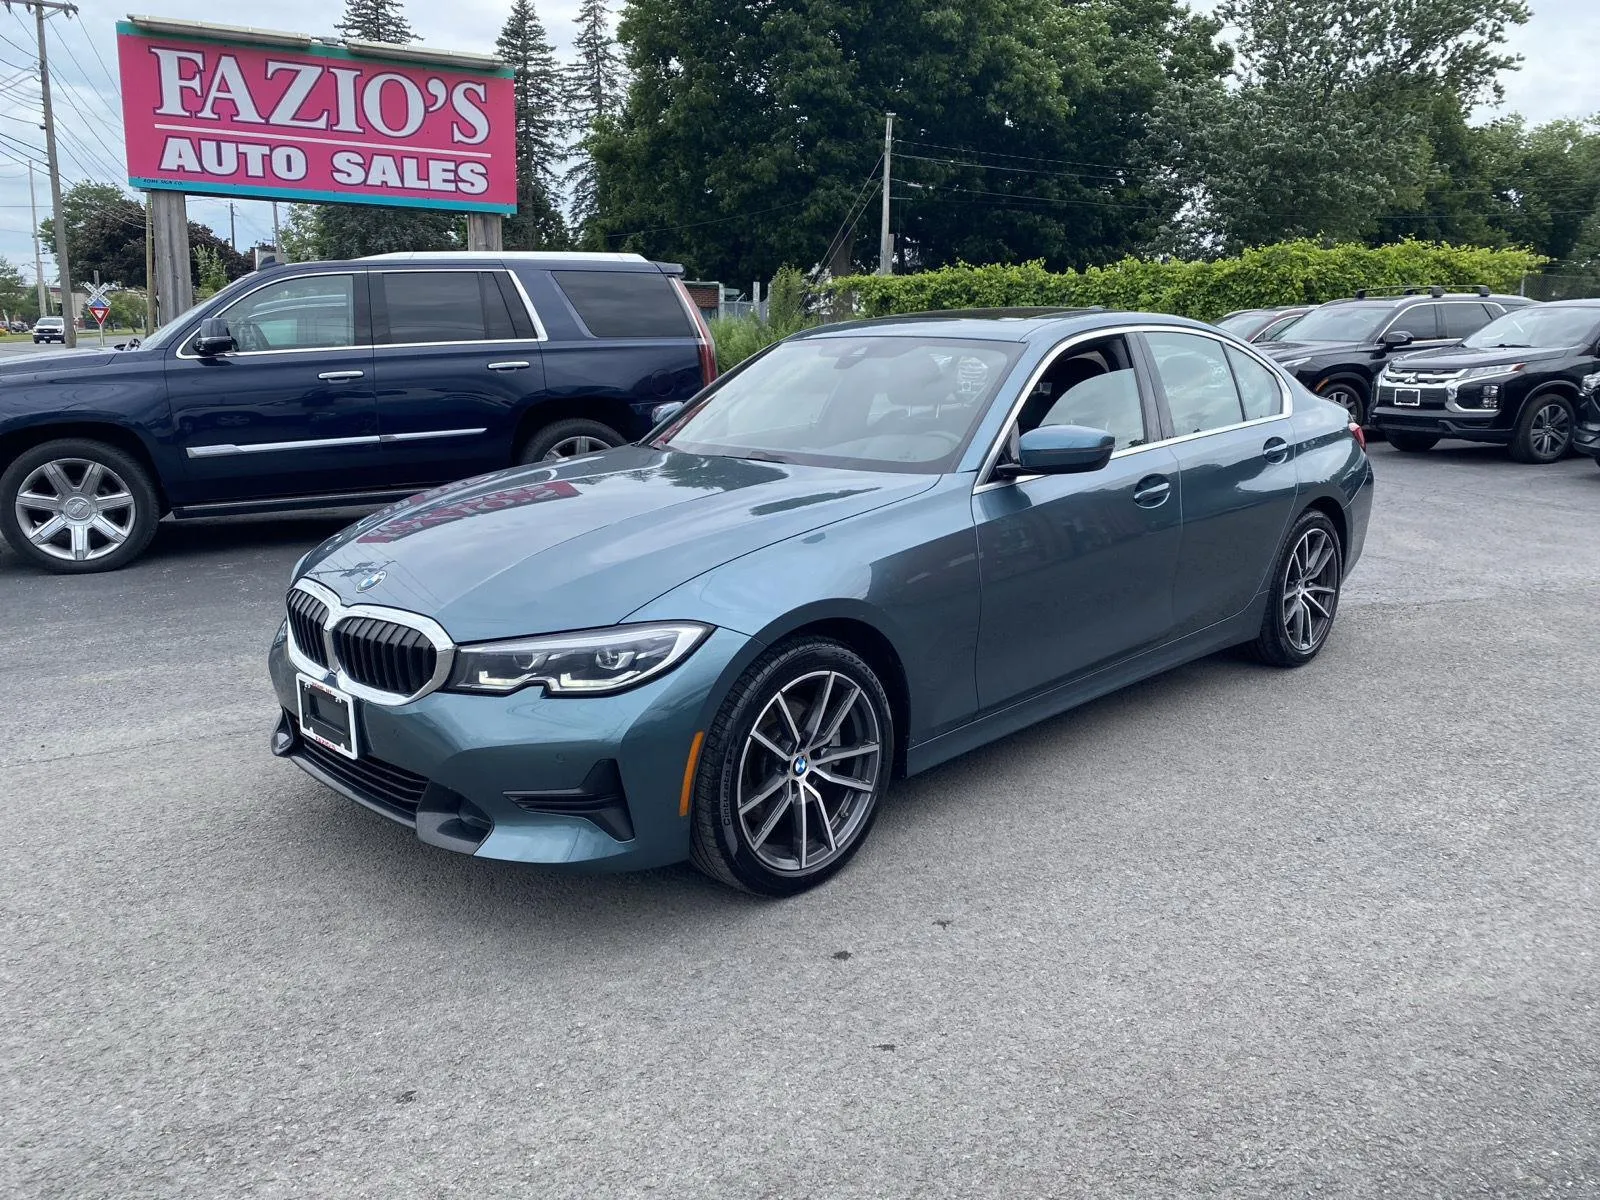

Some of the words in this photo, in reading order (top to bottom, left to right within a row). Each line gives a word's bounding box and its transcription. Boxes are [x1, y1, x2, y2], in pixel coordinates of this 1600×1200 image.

[148, 46, 491, 146] FAZIO'S
[158, 136, 308, 182] AUTO
[331, 151, 490, 196] SALES
